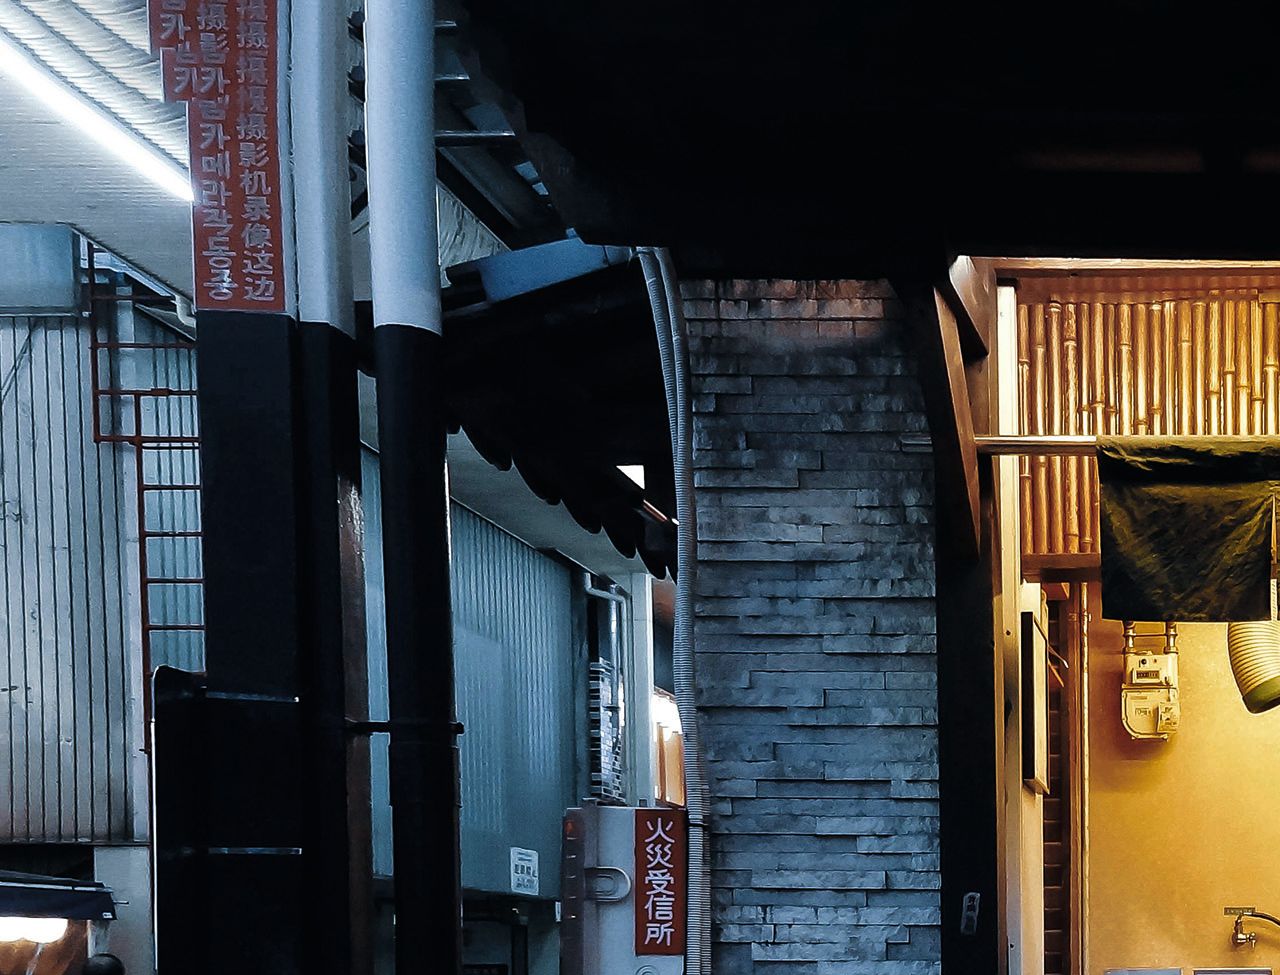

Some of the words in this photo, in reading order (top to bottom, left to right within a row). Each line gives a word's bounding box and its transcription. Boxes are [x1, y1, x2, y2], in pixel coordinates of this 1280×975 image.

[644, 817, 676, 947] 火災受信所
